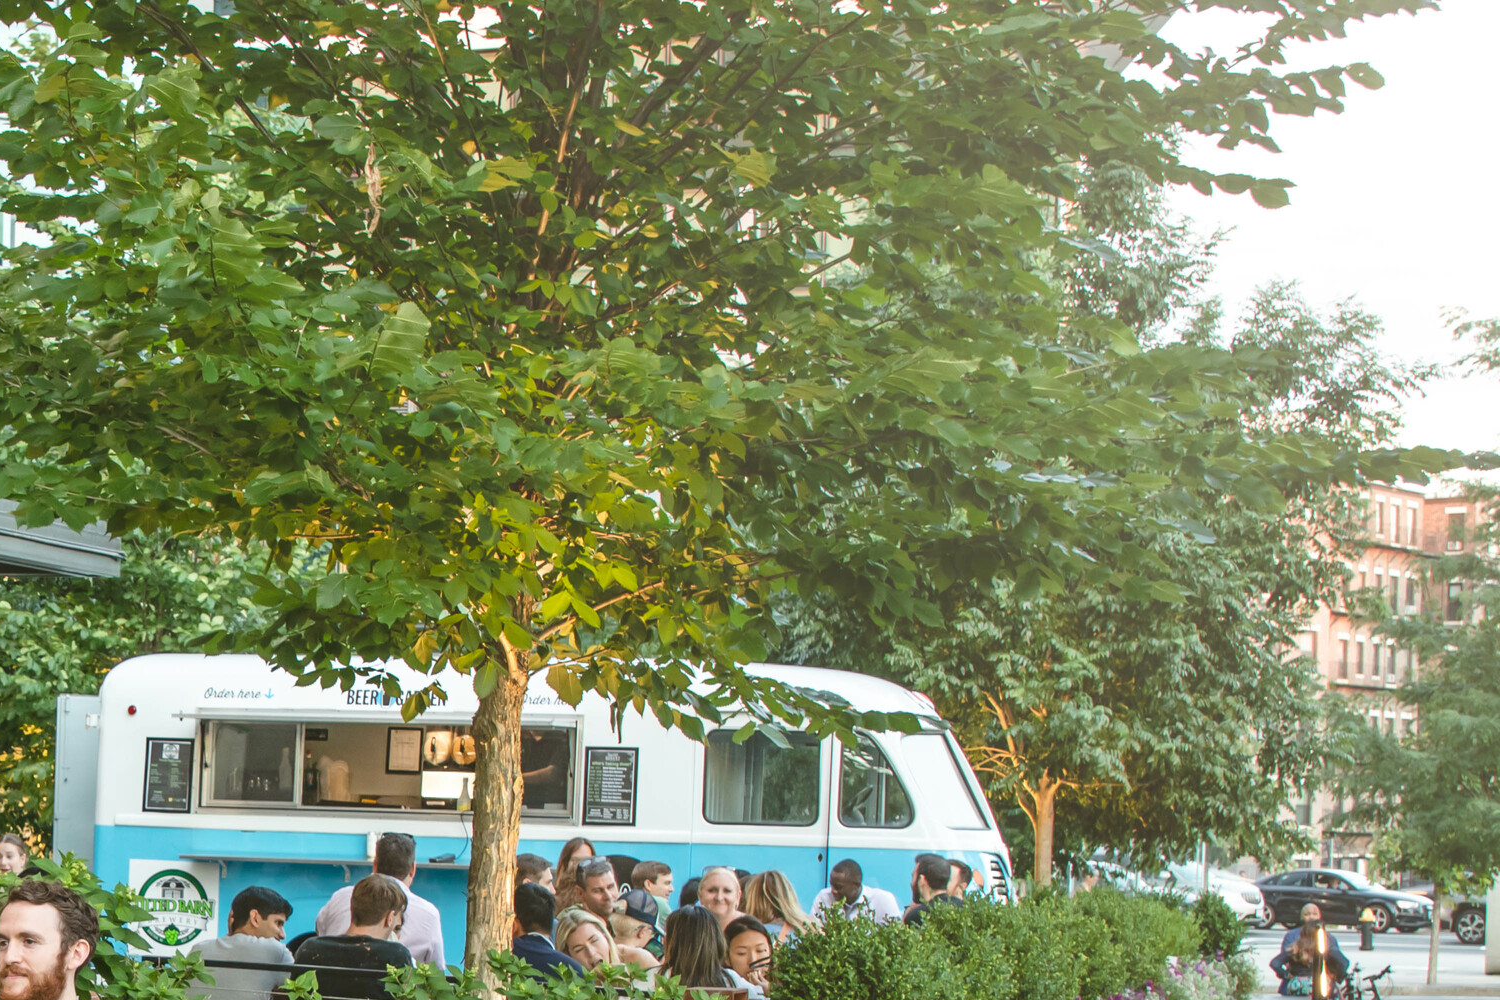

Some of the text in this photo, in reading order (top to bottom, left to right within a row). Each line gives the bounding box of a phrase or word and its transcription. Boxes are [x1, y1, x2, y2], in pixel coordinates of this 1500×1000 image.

[204, 687, 261, 699] Order here
[346, 689, 447, 706] BEER GAEN
[135, 898, 214, 918] ILTED BARN
